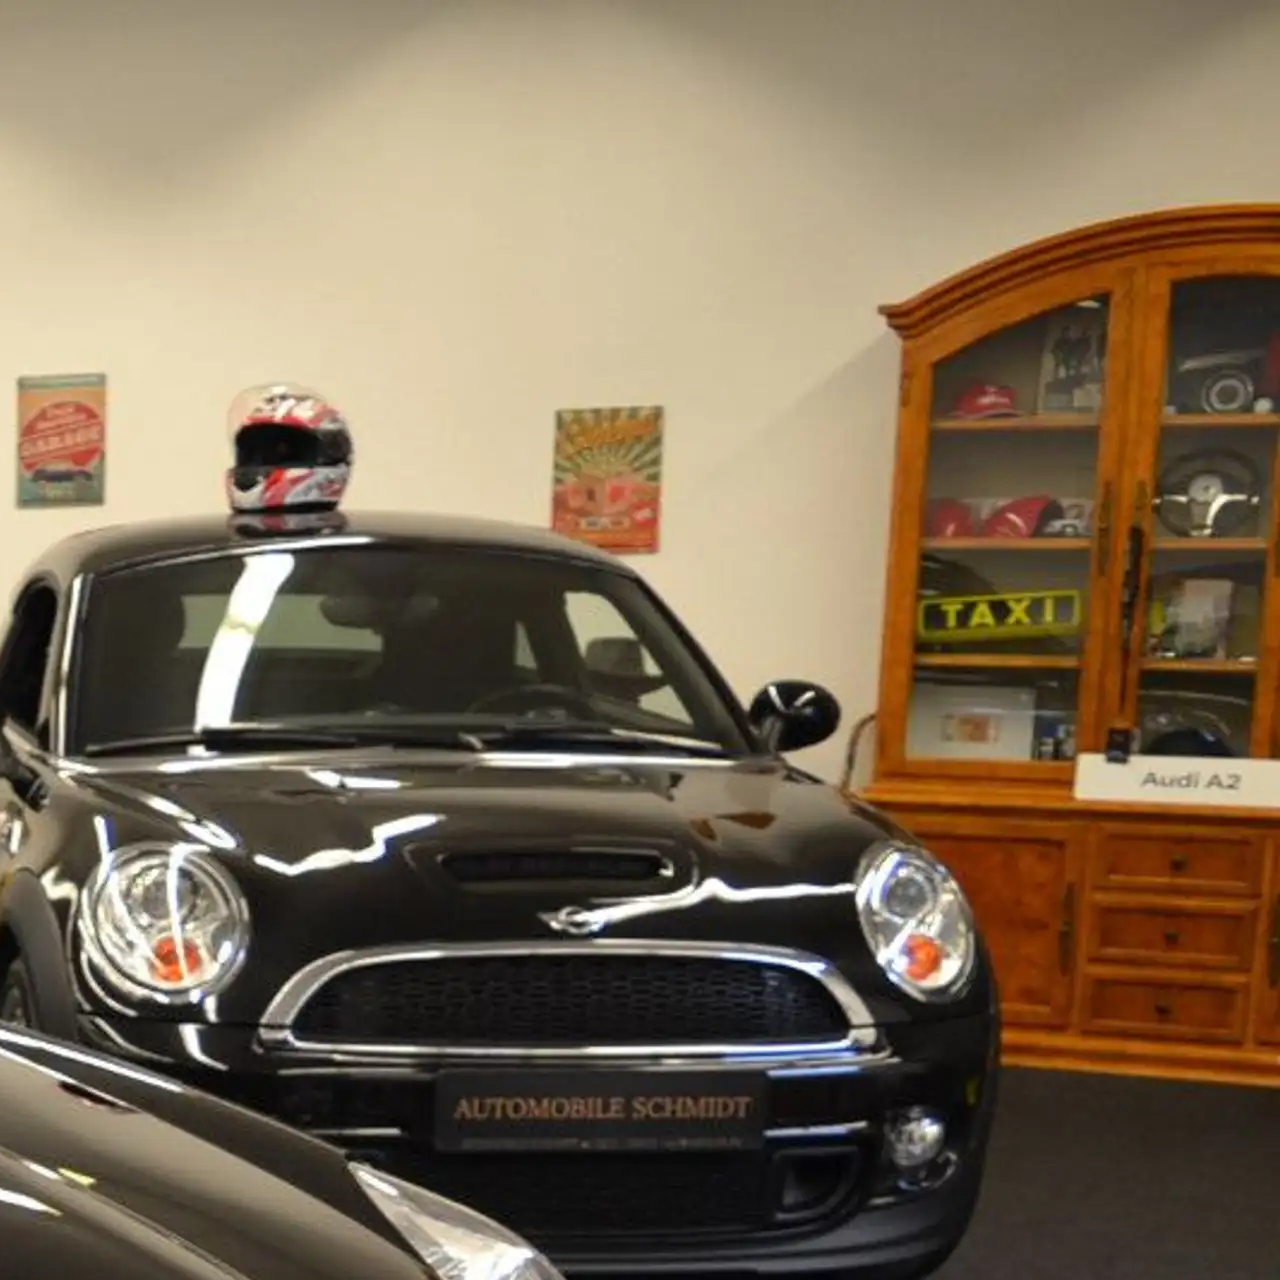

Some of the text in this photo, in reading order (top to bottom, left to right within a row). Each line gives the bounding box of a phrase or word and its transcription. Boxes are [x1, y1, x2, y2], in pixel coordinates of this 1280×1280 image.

[940, 597, 1054, 629] TAXI
[1140, 771, 1242, 789] Audi A2
[453, 1096, 752, 1119] AUTOMOBILE SCHMIDT
